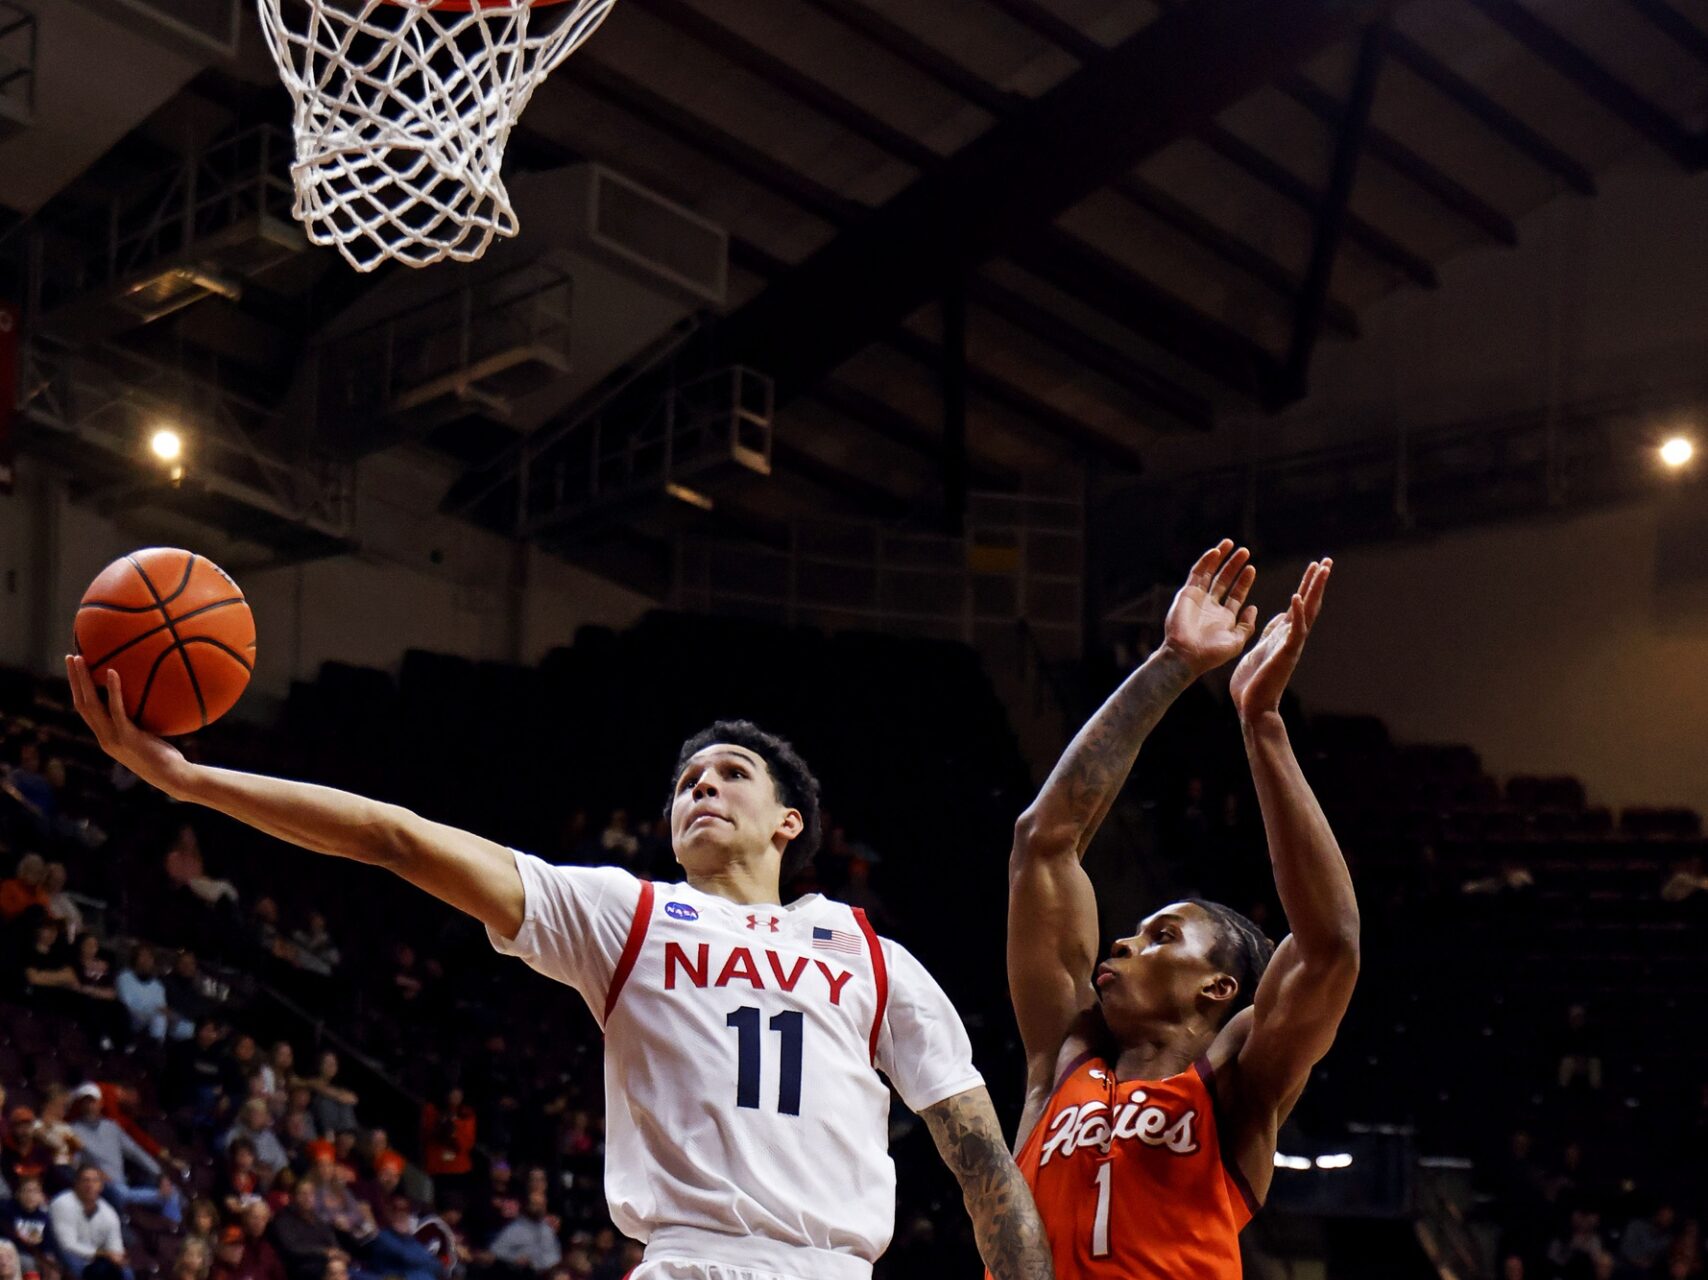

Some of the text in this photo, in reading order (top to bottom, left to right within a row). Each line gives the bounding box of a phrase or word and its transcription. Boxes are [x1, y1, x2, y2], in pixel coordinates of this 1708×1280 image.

[667, 905, 698, 920] NASA
[664, 942, 853, 1006] NAVY
[726, 1005, 804, 1117] 11
[1093, 1160, 1111, 1257] 1
